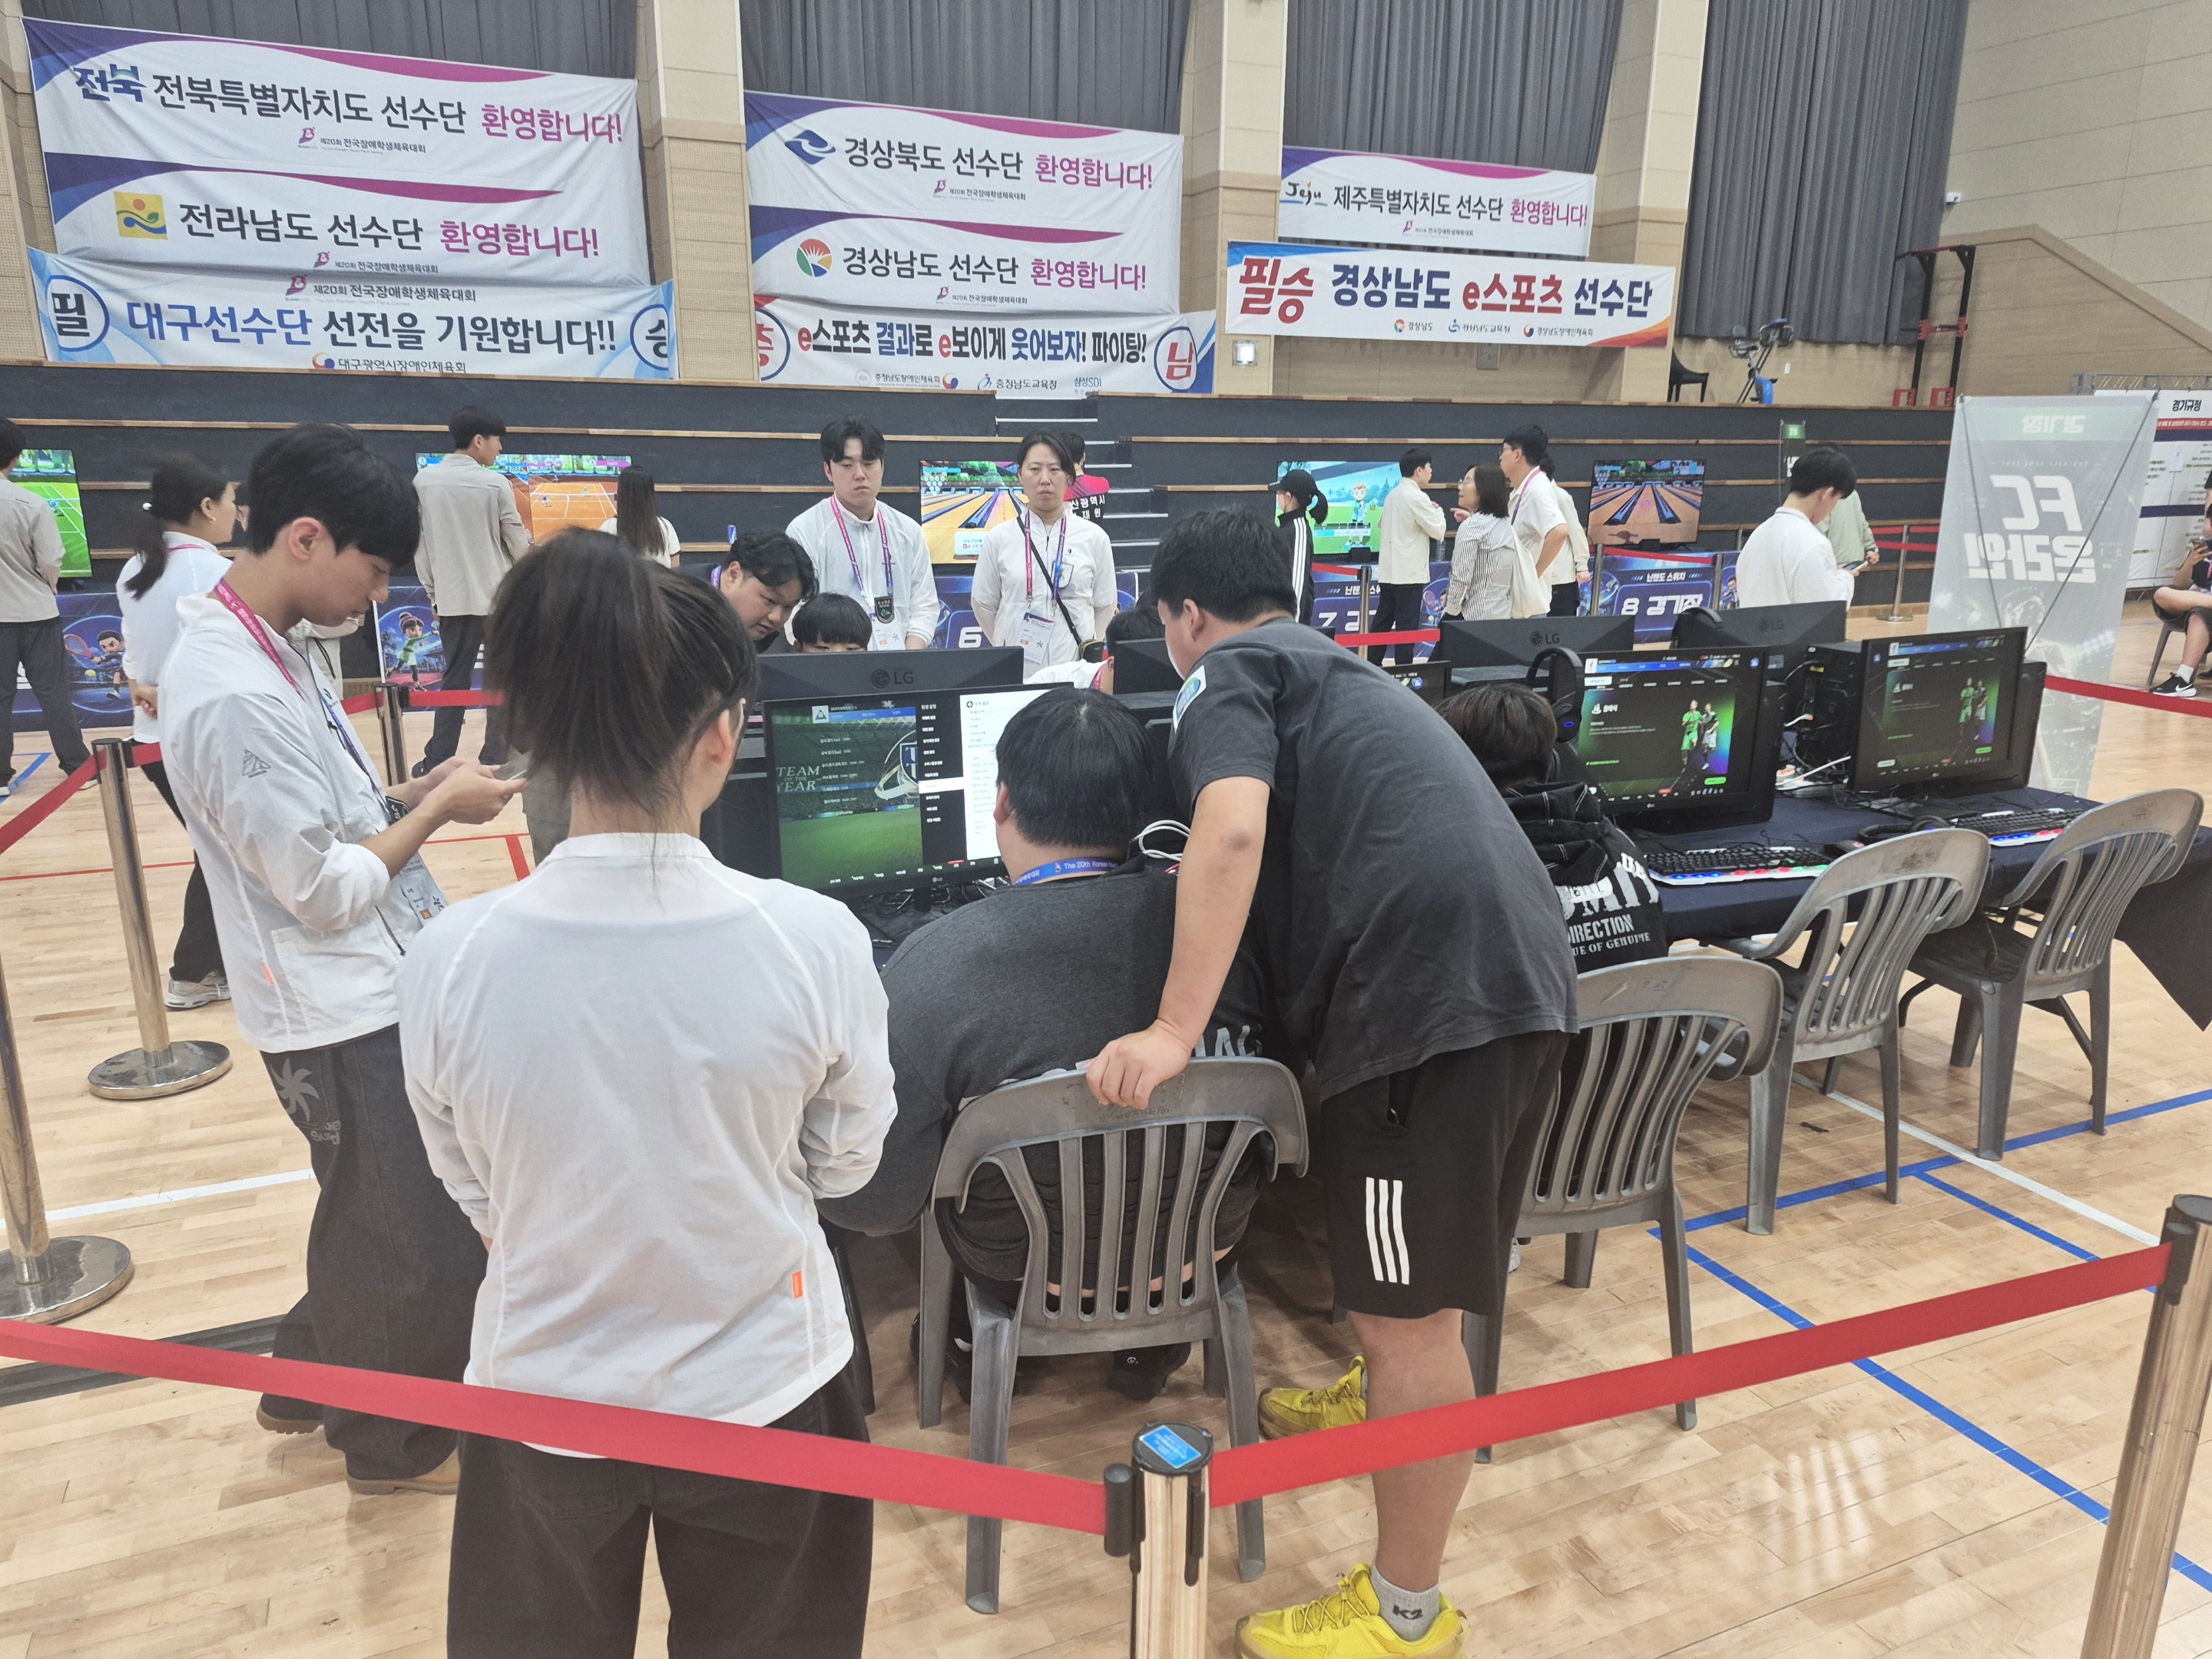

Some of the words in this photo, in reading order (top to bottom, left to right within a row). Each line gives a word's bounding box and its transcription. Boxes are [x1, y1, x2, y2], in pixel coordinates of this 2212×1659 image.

[73, 64, 147, 103] 전북
[153, 75, 373, 123] 전북특별자치도
[381, 96, 466, 134] 선수단
[482, 104, 623, 144] 환영합니다!
[343, 138, 426, 153] 전국장애학생체육대회
[845, 137, 945, 173] 경상북도
[952, 147, 1023, 180] 선수단
[1035, 154, 1152, 190] 환영합니다!
[1285, 181, 1321, 206] Jeju
[1333, 185, 1452, 217] 제주특별자치도
[1457, 194, 1503, 222] 선수단
[1510, 198, 1588, 227] 환영합니다!
[179, 204, 319, 243] 전라남도
[327, 214, 422, 250] 선수단
[440, 220, 598, 259] 환영합니다!
[843, 247, 942, 280] 경상남도
[948, 256, 1018, 285] 선수단
[1031, 258, 1147, 291] 환영합니다!
[313, 285, 346, 296] 제20회
[349, 284, 476, 302] 전국장애학생체육대회
[1238, 257, 1314, 323] 필승
[1332, 264, 1451, 309] 경상남도
[1462, 273, 1563, 314] e스포츠
[1574, 277, 1654, 318] 선수단
[51, 293, 91, 337] 필
[127, 302, 313, 346] 대구선수단
[323, 311, 426, 350] 선전을
[436, 316, 616, 356] 기원합니다!!
[1408, 321, 1433, 331] 경상남도
[797, 319, 871, 354] e스포츠
[876, 321, 934, 357] 결과로
[939, 326, 1006, 361] e보이게
[1012, 327, 1087, 363] 웃어보자!
[1091, 331, 1147, 364] 파이팅!
[338, 358, 466, 374] 대구광역시장애인체육회
[1166, 342, 1194, 381] 남
[875, 373, 940, 383] 충청남도장애인체육회
[996, 379, 1058, 390] 충청남도교육청
[1075, 377, 1101, 388] 삼성SDI
[2172, 399, 2202, 412] 경기규정
[1071, 494, 1105, 510] 산광역시
[1647, 572, 1666, 582] 닌텐도
[1666, 571, 1686, 582] 스위치
[1345, 586, 1360, 595] 닌텐
[1621, 598, 1640, 615] 8
[959, 626, 982, 648] 6
[1545, 633, 1560, 644] LG
[893, 671, 915, 684] LG
[776, 766, 820, 777] TEAM
[777, 780, 816, 793] YEAR
[1573, 945, 1587, 956] UE
[1588, 942, 1603, 953] OF
